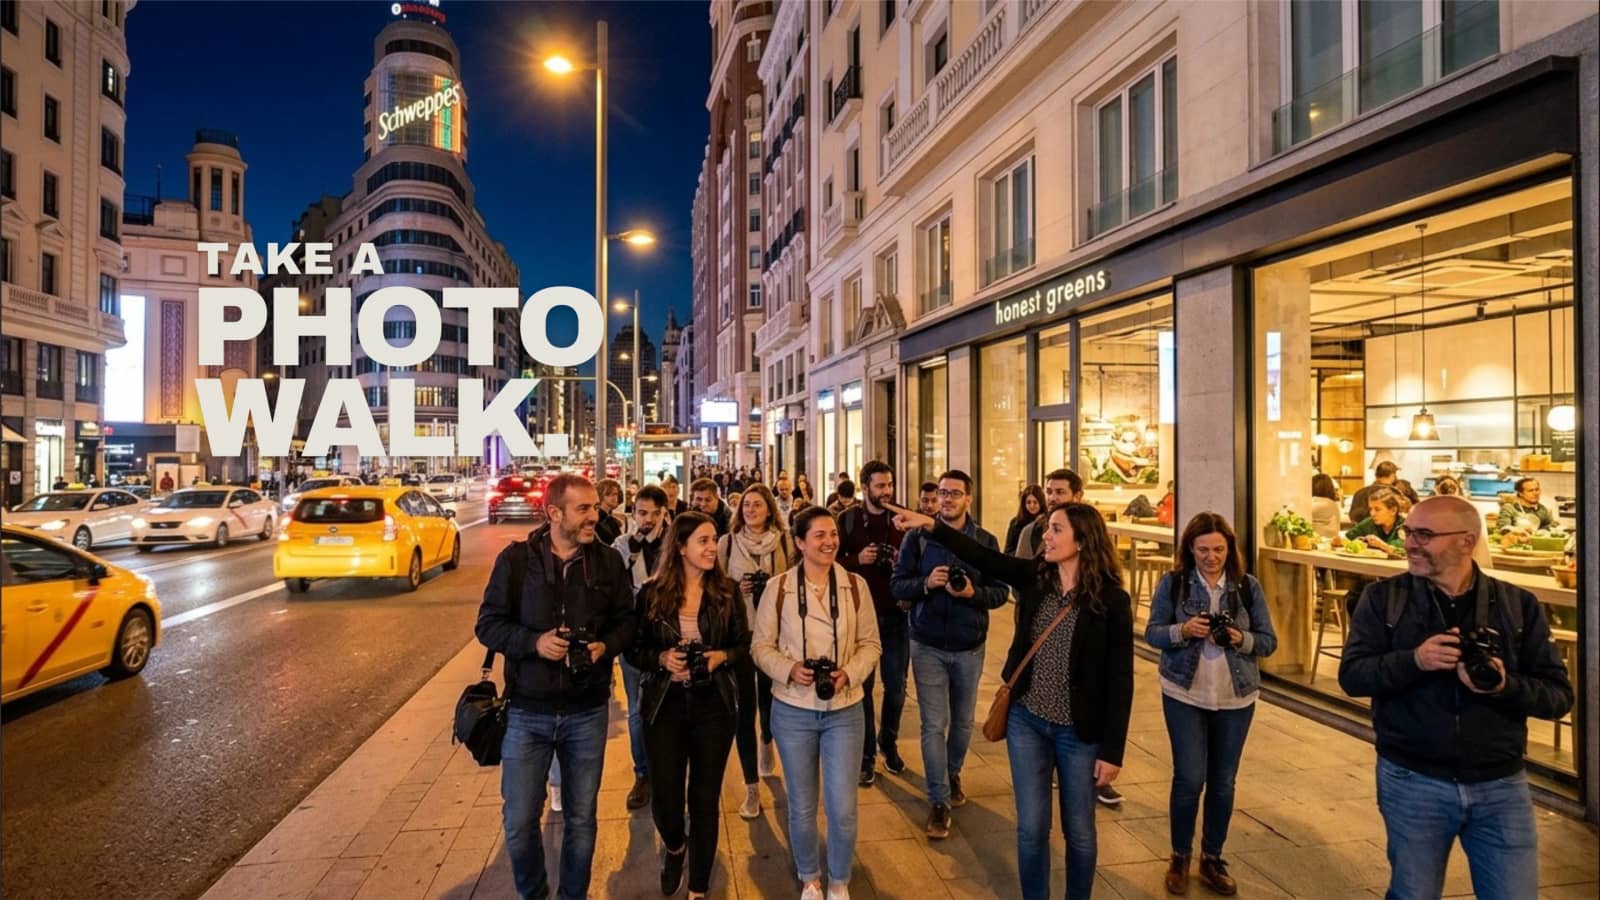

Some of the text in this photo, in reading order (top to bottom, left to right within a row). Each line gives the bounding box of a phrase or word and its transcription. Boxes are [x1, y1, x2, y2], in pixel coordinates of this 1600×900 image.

[378, 85, 461, 140] Schweppes
[995, 270, 1106, 325] honest greens
